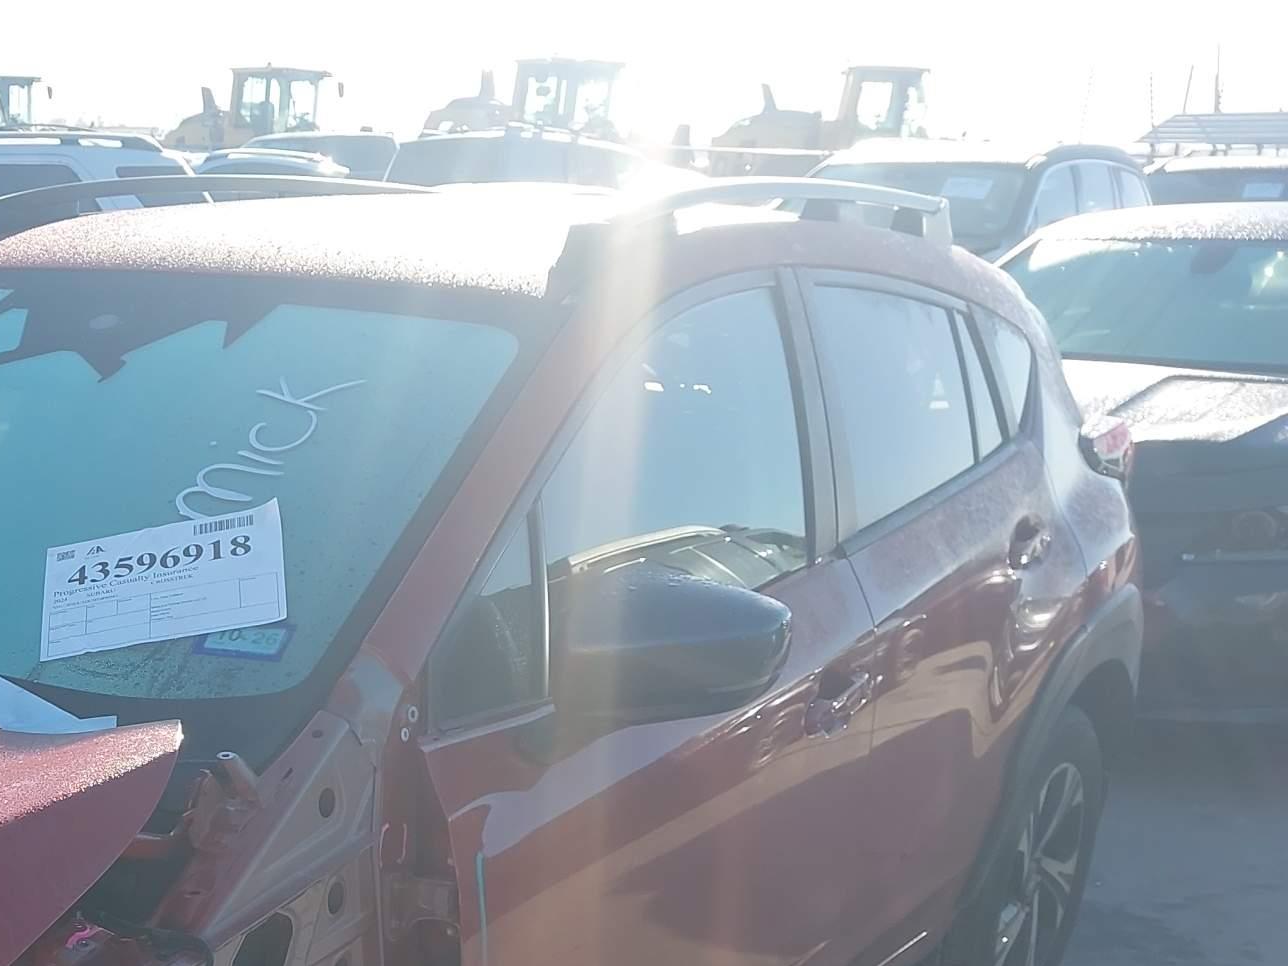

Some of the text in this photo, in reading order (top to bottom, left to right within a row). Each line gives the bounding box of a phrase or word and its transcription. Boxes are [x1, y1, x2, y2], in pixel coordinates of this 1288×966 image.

[53, 565, 200, 597] Progressive Casualty Insurance
[67, 535, 252, 586] 43596918
